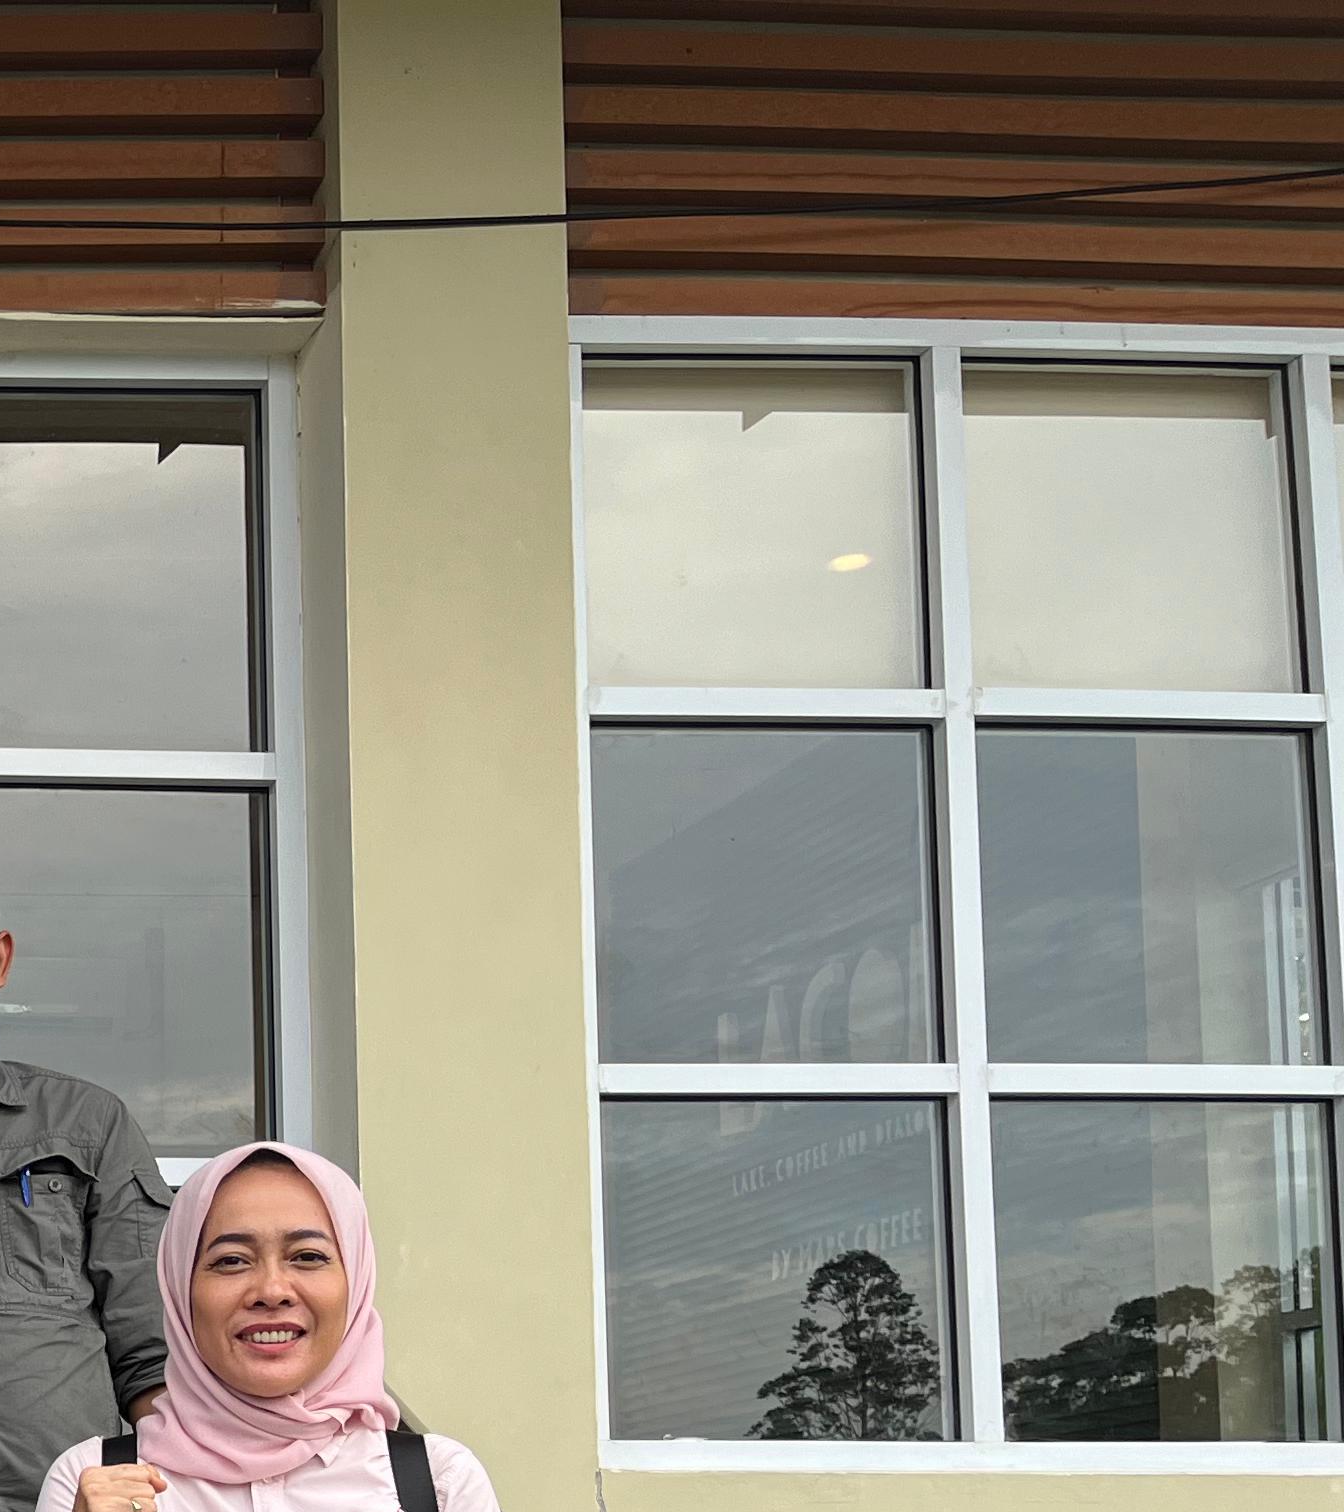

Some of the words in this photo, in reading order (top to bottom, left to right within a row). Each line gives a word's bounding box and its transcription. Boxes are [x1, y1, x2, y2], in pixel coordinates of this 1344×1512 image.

[776, 1142, 828, 1182] COFFEE
[838, 1129, 867, 1159] AND
[875, 1109, 929, 1146] DIALO
[855, 1207, 922, 1252] COFFEE
